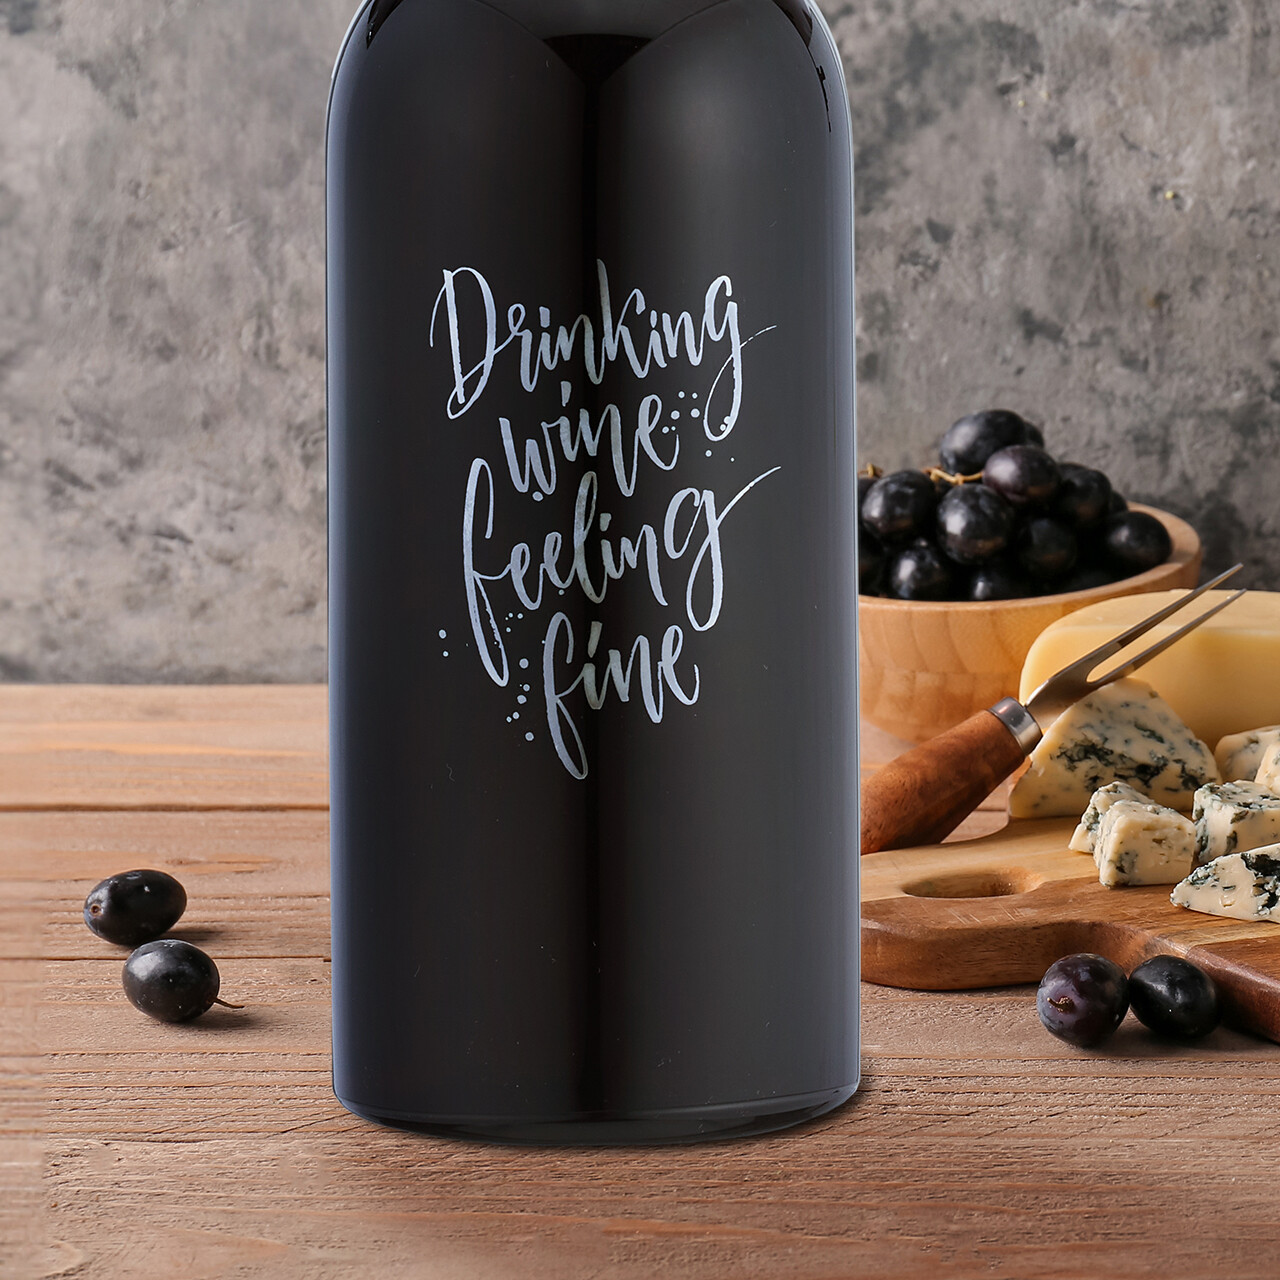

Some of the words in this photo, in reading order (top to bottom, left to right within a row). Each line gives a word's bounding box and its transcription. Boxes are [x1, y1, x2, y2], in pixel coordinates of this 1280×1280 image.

[430, 259, 777, 441] Drinking
[499, 381, 679, 497] wine
[463, 458, 781, 687] feeling
[542, 612, 699, 780] fine
